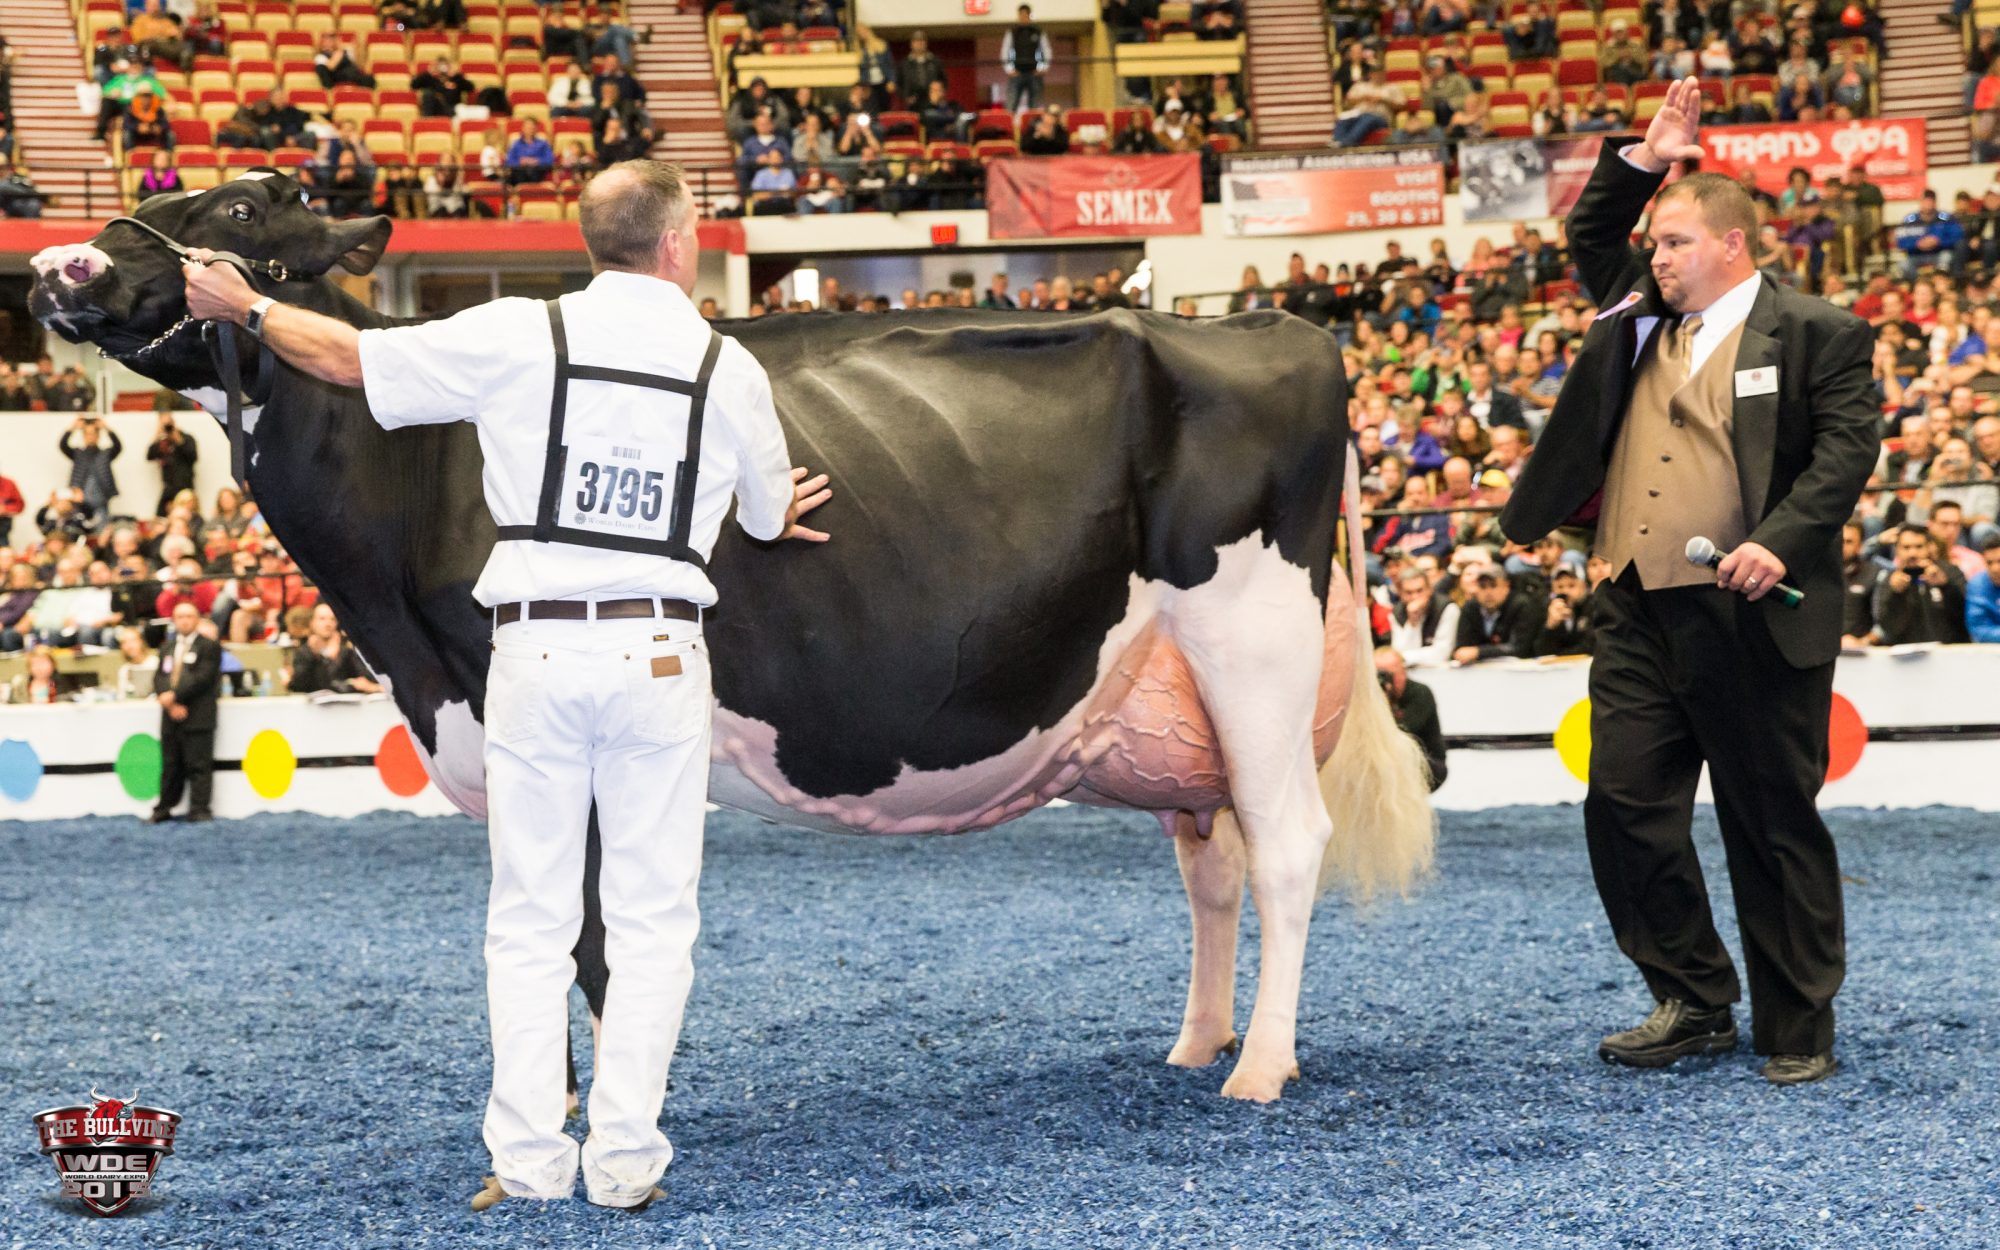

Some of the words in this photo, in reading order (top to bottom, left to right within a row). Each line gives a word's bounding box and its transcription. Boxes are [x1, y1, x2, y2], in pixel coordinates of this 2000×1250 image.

[1301, 153, 1396, 169] Association
[1398, 149, 1432, 166] USA
[1708, 131, 1820, 164] TRANS
[1395, 169, 1439, 186] VISIT
[1076, 188, 1173, 226] SEMEX
[1370, 190, 1439, 208] BOOTHS
[576, 461, 664, 522] 3795
